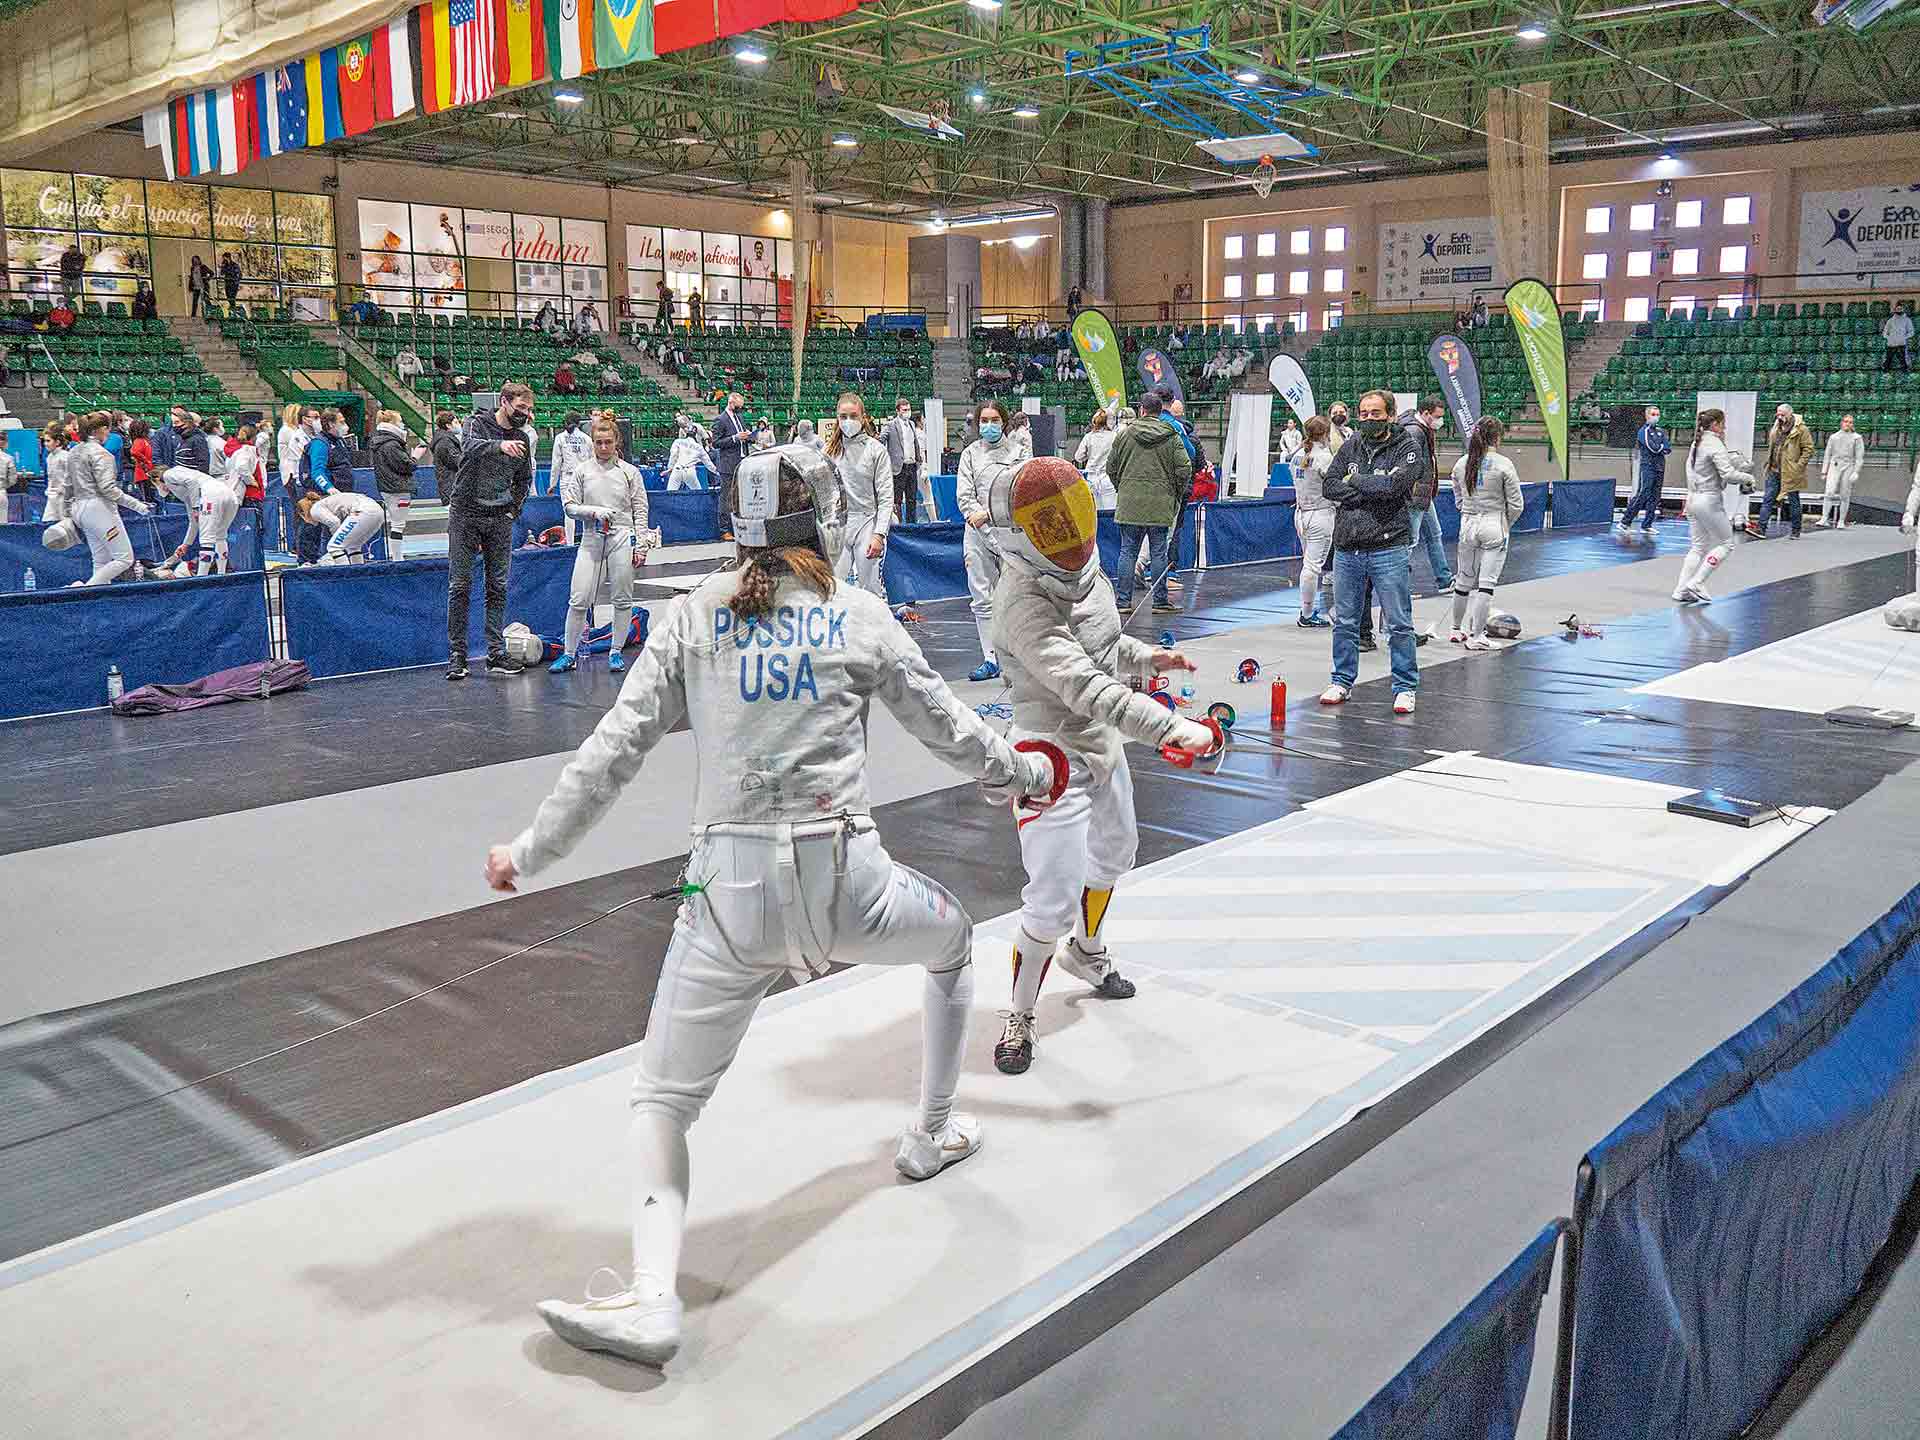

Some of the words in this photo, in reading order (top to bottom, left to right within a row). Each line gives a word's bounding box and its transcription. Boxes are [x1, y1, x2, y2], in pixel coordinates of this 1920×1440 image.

[111, 195, 130, 218] el
[1857, 223, 1920, 242] DEPORTE
[669, 248, 697, 267] mejor
[1437, 243, 1472, 257] DEPORTE
[333, 521, 357, 545] ITALIA
[740, 653, 819, 702] USA
